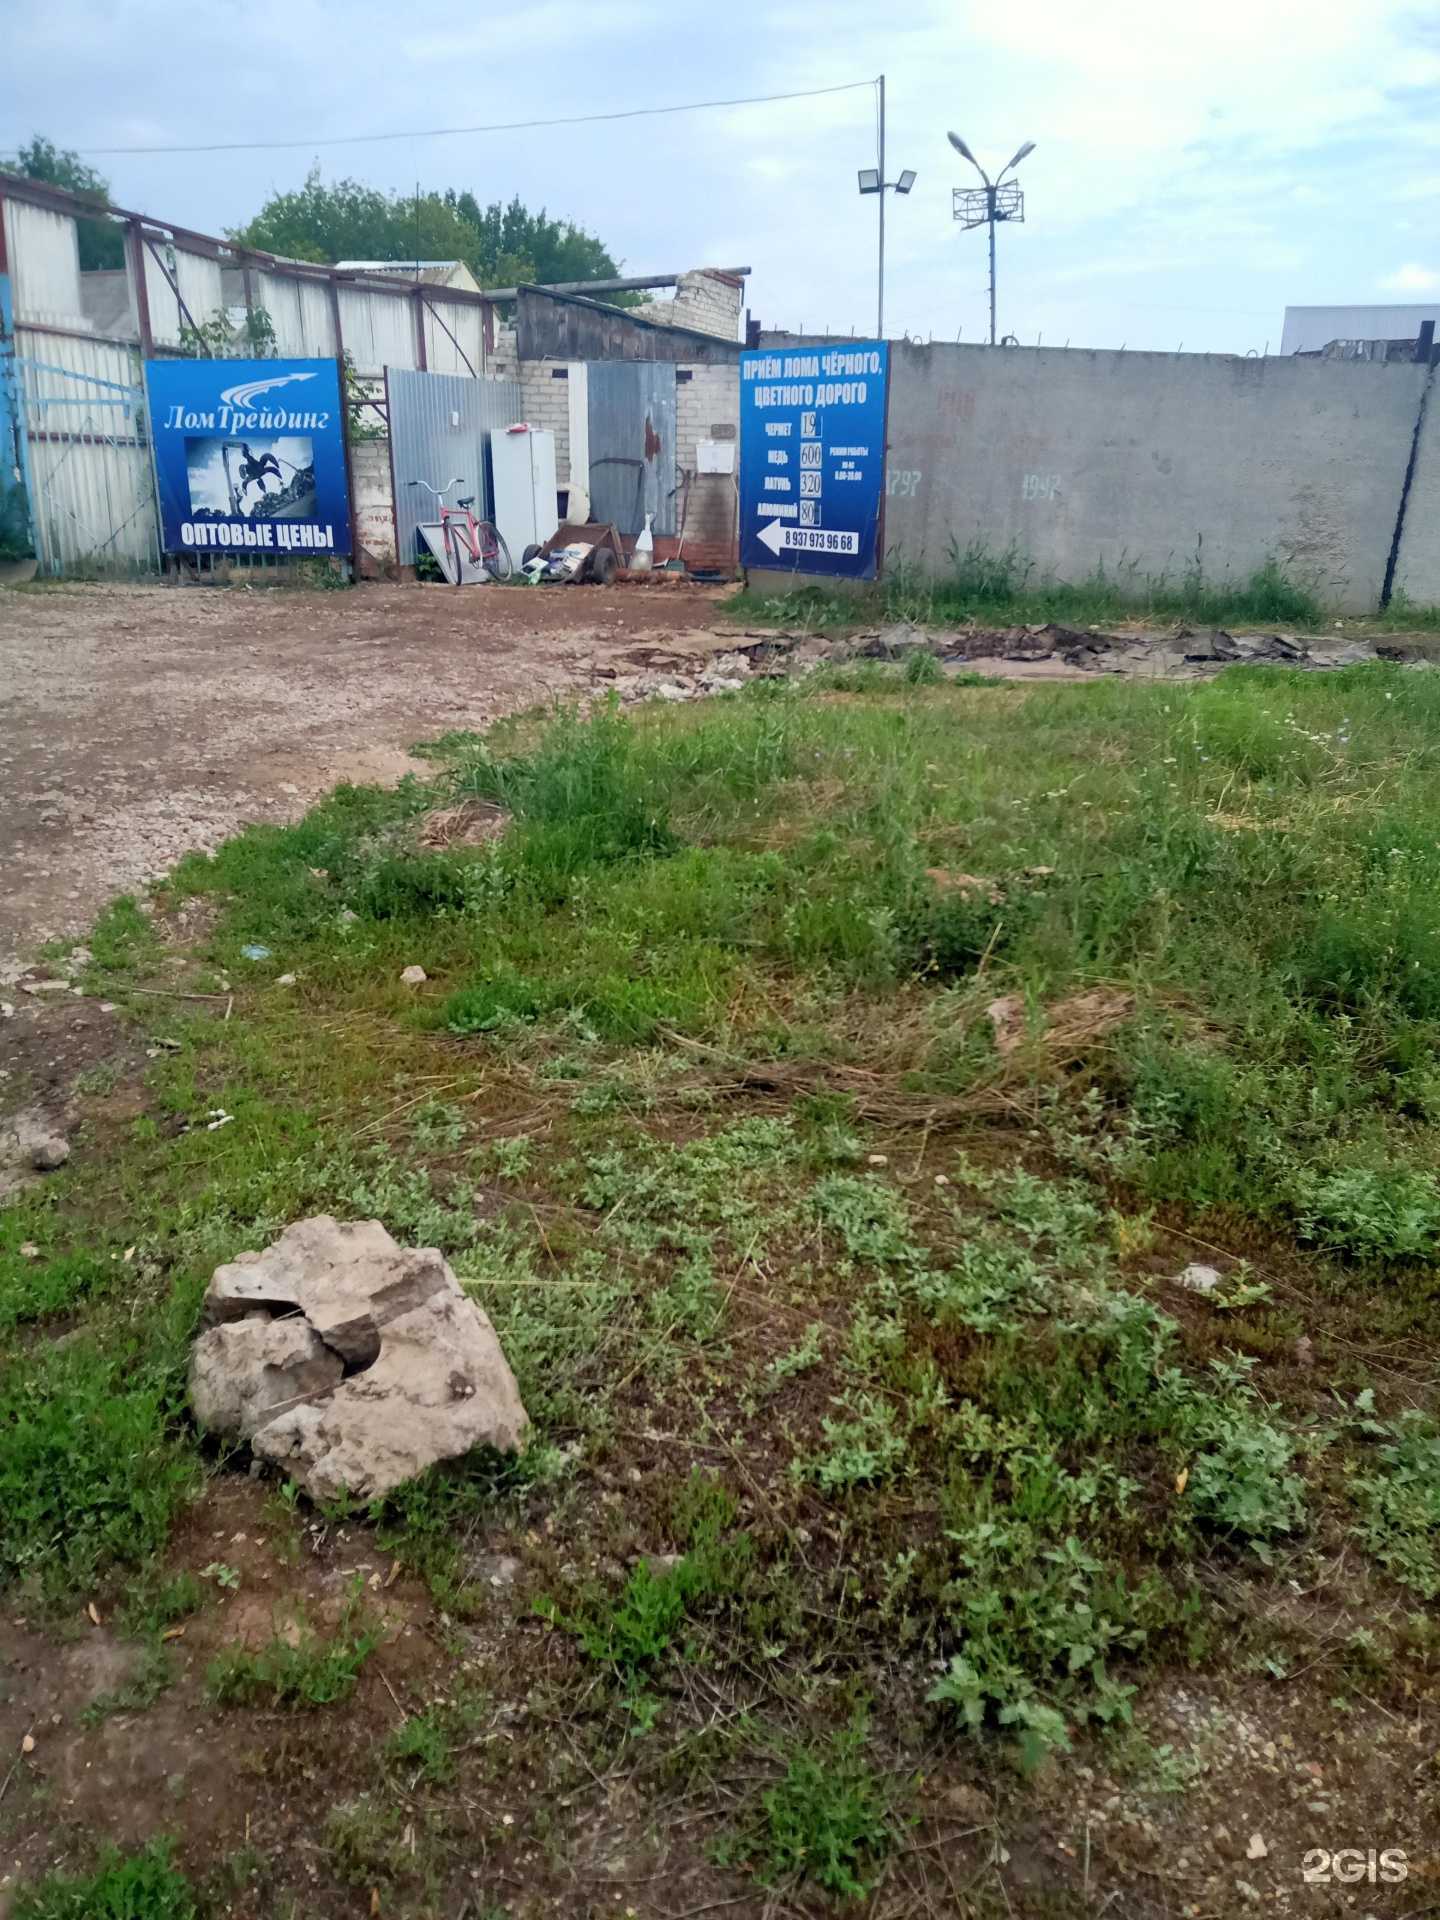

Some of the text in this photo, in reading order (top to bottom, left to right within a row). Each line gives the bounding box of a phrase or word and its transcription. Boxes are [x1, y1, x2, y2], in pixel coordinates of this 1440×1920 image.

[744, 351, 882, 380] ПРИЁМ ЛОМА ЧЁРНОГО,
[754, 382, 867, 409] ЦВЕТНОГО ДОРОГО
[803, 412, 816, 434] 19
[801, 445, 821, 465] 600
[801, 474, 821, 493] 320
[181, 522, 334, 550] ОПТОВЫЕ ЦЕНЫ
[785, 531, 853, 551] 8 937 973 96 68
